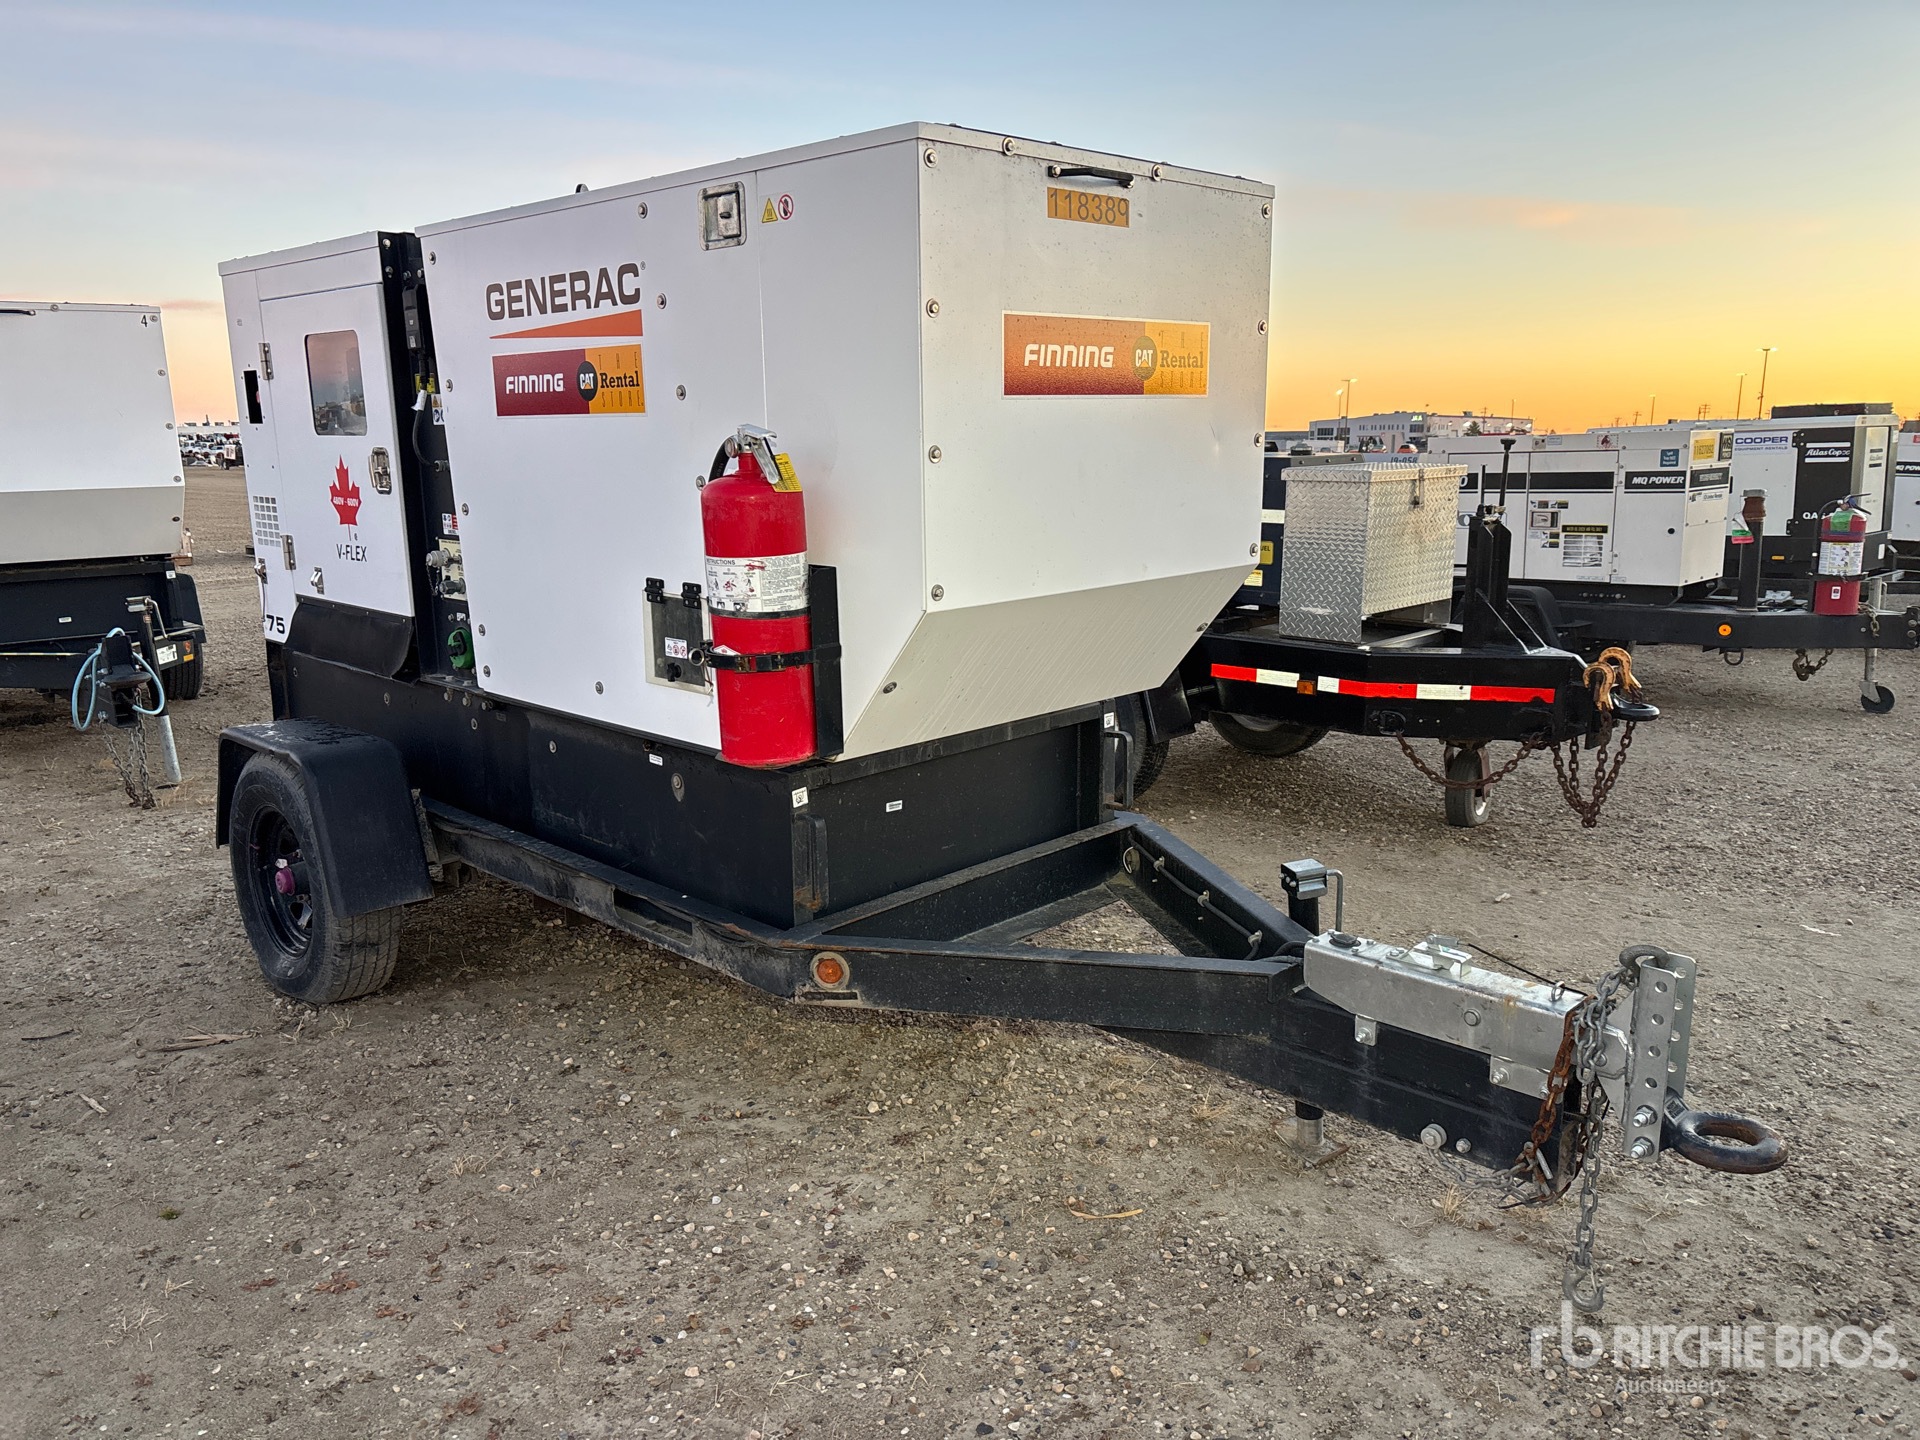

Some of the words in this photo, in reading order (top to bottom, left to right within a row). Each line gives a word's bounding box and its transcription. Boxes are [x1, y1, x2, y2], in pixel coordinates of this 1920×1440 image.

[1050, 188, 1129, 226] 118389
[485, 263, 641, 321] GENERAC
[140, 314, 148, 328] 4
[1159, 330, 1205, 349] THE
[597, 351, 639, 371] THE
[1023, 343, 1115, 368] FINNING
[1135, 348, 1154, 369] CAT
[1159, 350, 1205, 370] Rental
[505, 372, 564, 395] FINNING
[579, 372, 595, 391] CAT
[599, 370, 641, 389] Rental
[1734, 436, 1789, 445] COOPER
[1804, 448, 1828, 457] Atlas
[1631, 476, 1648, 486] MQ
[1648, 476, 1684, 485] POWER
[336, 543, 368, 563] V-FLEX
[265, 614, 286, 635] 75
